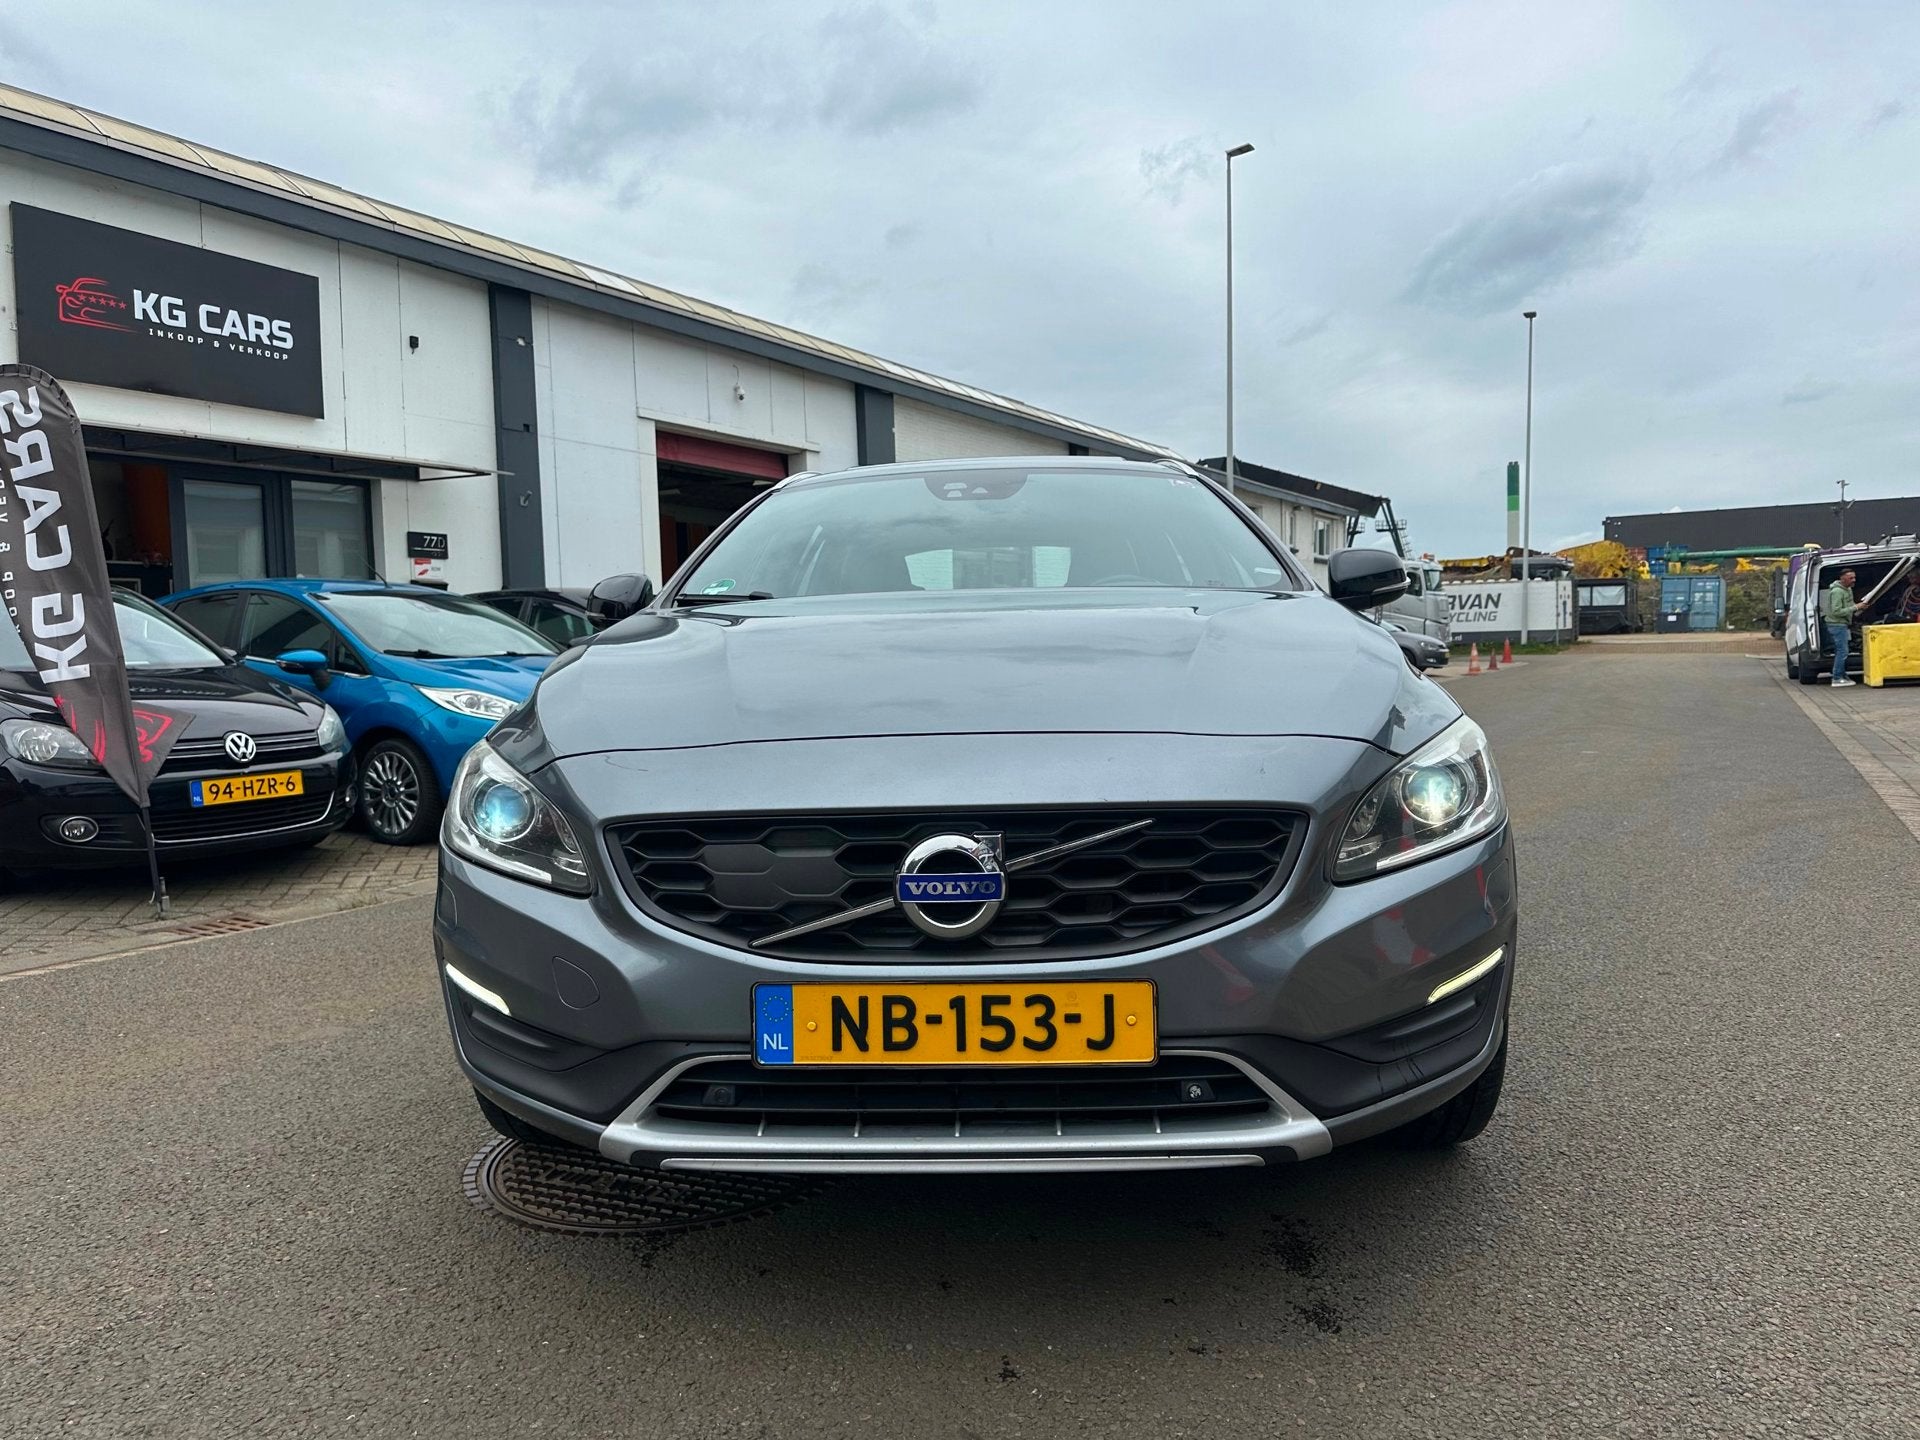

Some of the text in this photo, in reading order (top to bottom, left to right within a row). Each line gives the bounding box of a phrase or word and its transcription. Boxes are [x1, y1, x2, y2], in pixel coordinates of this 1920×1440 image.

[133, 289, 294, 350] KG CARS
[149, 328, 204, 345] INKOOP
[229, 343, 289, 360] VERKOOP
[208, 775, 296, 801] 94-HZR-6
[904, 880, 996, 896] VOLVO
[763, 993, 1116, 1053] NL NB-153-J
